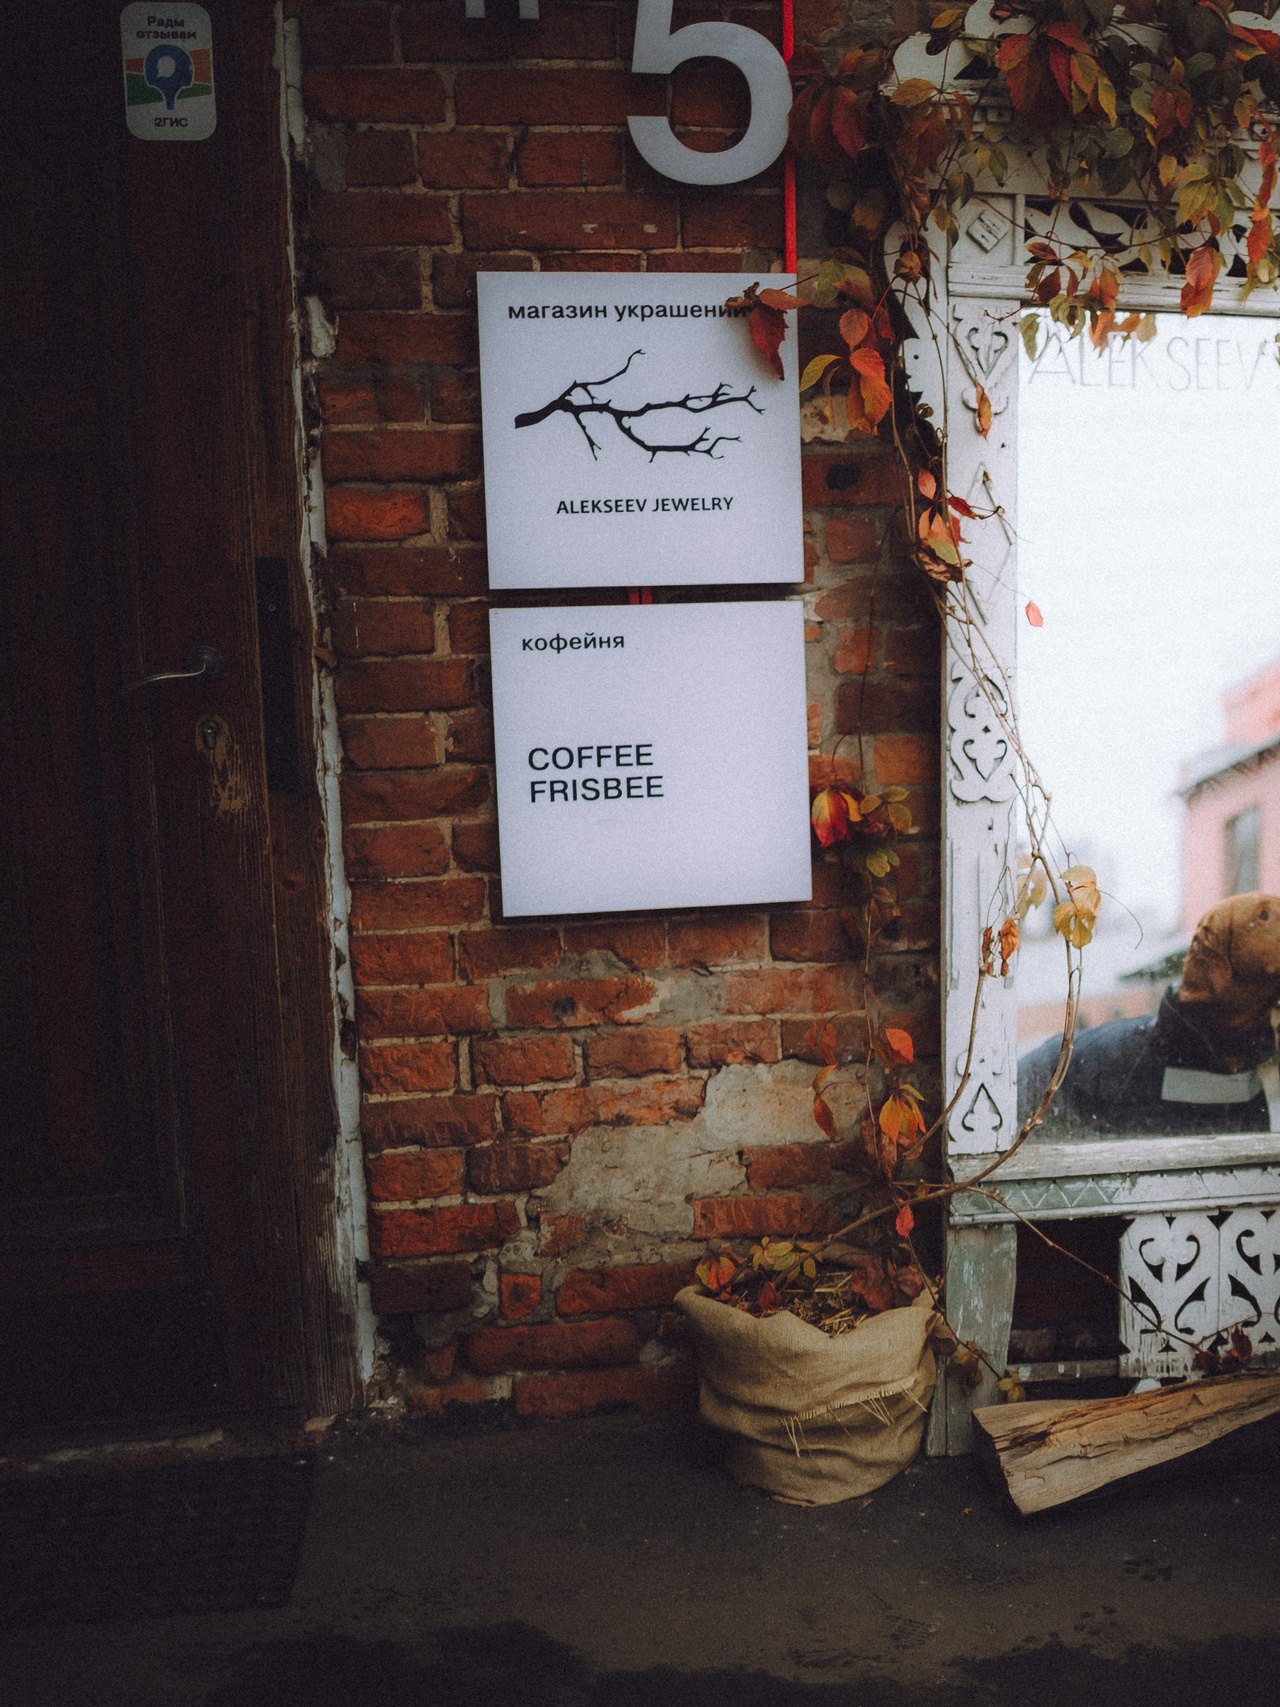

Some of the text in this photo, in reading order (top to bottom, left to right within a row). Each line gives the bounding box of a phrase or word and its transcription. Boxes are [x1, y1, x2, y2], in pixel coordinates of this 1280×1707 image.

[146, 15, 185, 28] Рады
[135, 30, 197, 39] отзывам
[627, 0, 793, 186] 5
[153, 117, 189, 127] 2ГИС
[508, 304, 607, 319] магазин
[556, 496, 734, 514] ALEKSEEV JEWELRY
[522, 631, 625, 654] кофейня
[528, 744, 654, 771] COFFEE
[530, 775, 664, 803] FRISBEE
